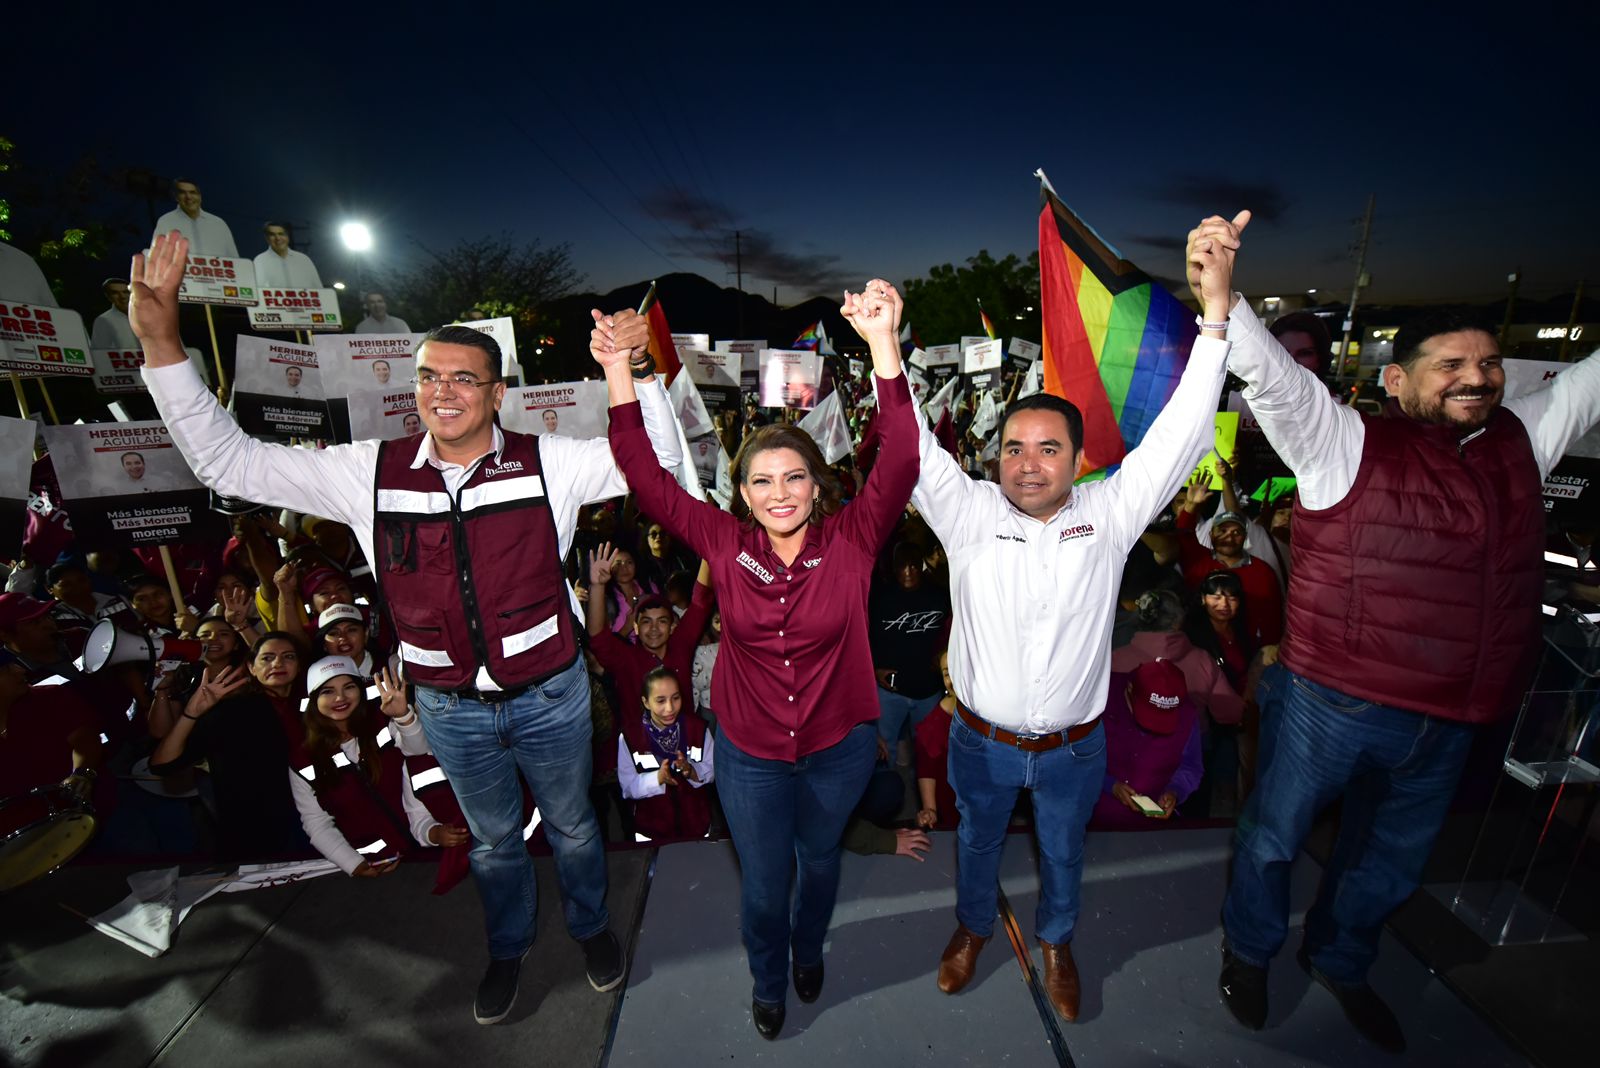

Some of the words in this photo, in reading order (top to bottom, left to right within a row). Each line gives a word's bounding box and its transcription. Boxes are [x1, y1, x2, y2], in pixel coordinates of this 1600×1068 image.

[263, 288, 319, 298] RAMÓN
[264, 298, 321, 307] FLORES
[349, 339, 410, 347] HERIBERTO
[42, 351, 59, 360] PT
[359, 347, 405, 355] AGUILAR
[43, 364, 90, 374] HISTORIA
[383, 392, 416, 403] HERIB
[522, 388, 575, 399] HERIBERTO
[531, 396, 570, 405] AGUILAR
[282, 407, 325, 418] bienestar,
[89, 426, 168, 439] HERIBERTO
[275, 423, 310, 431] morena
[103, 436, 162, 447] AGUILAR
[106, 510, 132, 519] Más
[134, 506, 192, 517] bienestar,
[116, 519, 142, 528] Más
[143, 515, 188, 526] Morena
[132, 528, 178, 539] morena
[739, 551, 775, 582] morena
